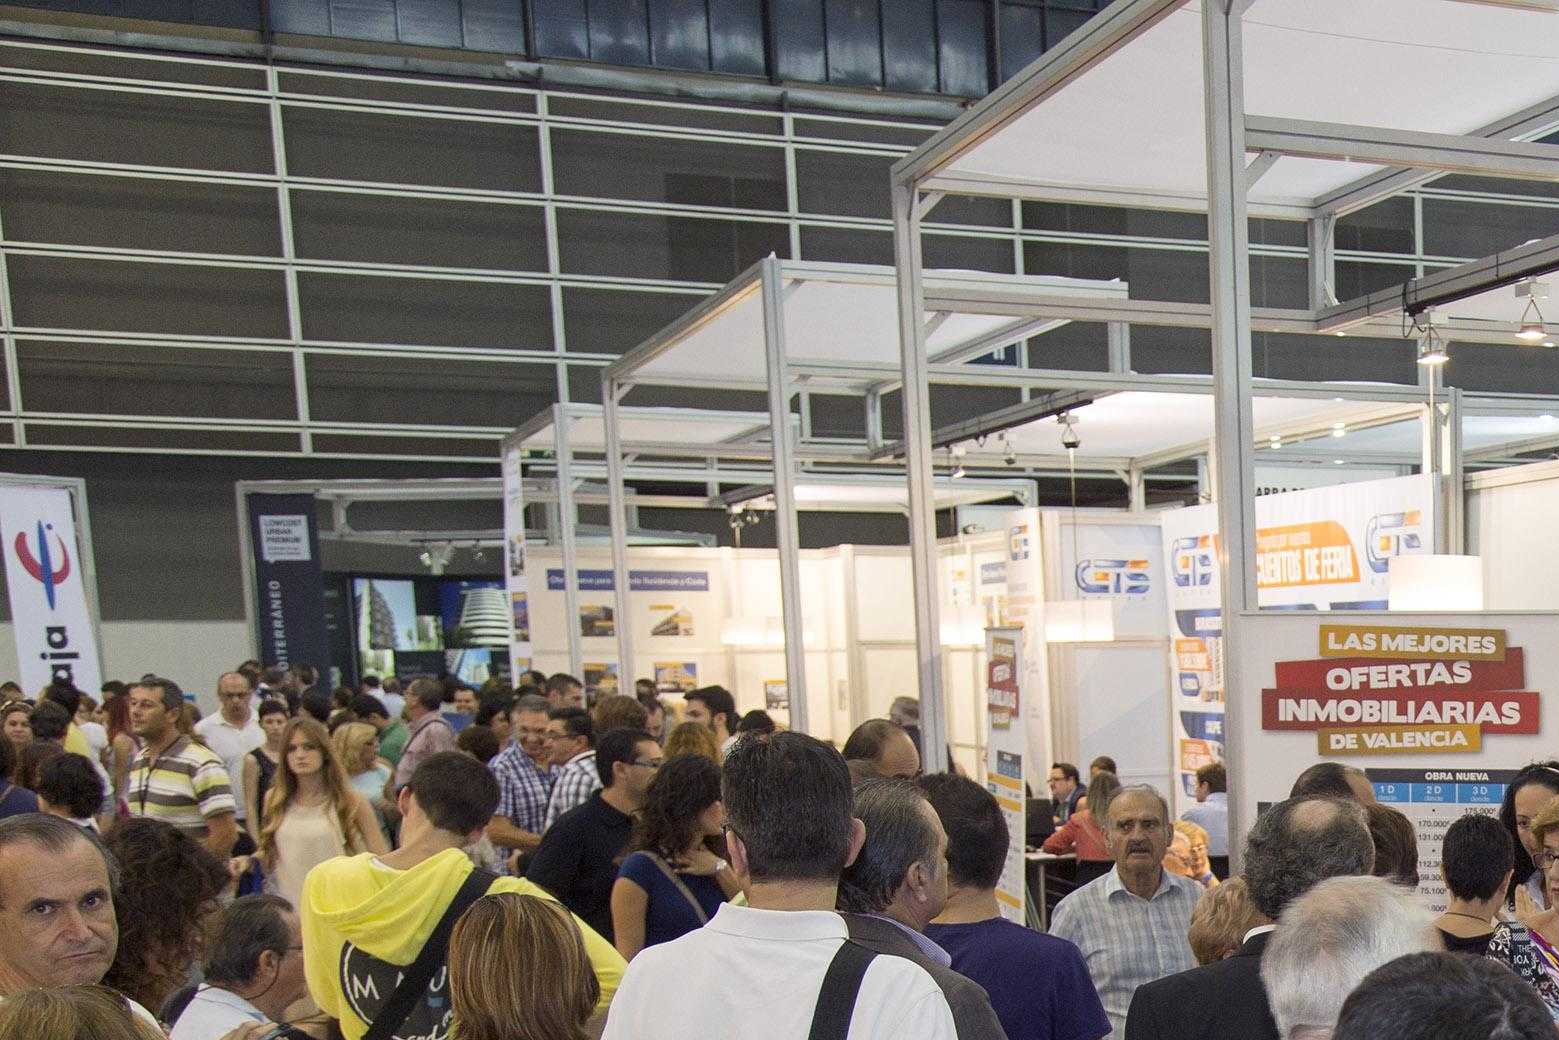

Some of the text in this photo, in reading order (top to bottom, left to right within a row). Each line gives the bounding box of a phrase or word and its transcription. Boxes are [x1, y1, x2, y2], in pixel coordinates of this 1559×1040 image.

[1321, 544, 1353, 579] FERIA
[1328, 632, 1496, 653] LAS MEJORES
[1326, 661, 1472, 690] OFERTAS
[1278, 699, 1521, 725] INMOBILIARIAS
[1330, 730, 1468, 750] DE VALENCIA
[1425, 772, 1489, 781] OBRA NUEVA
